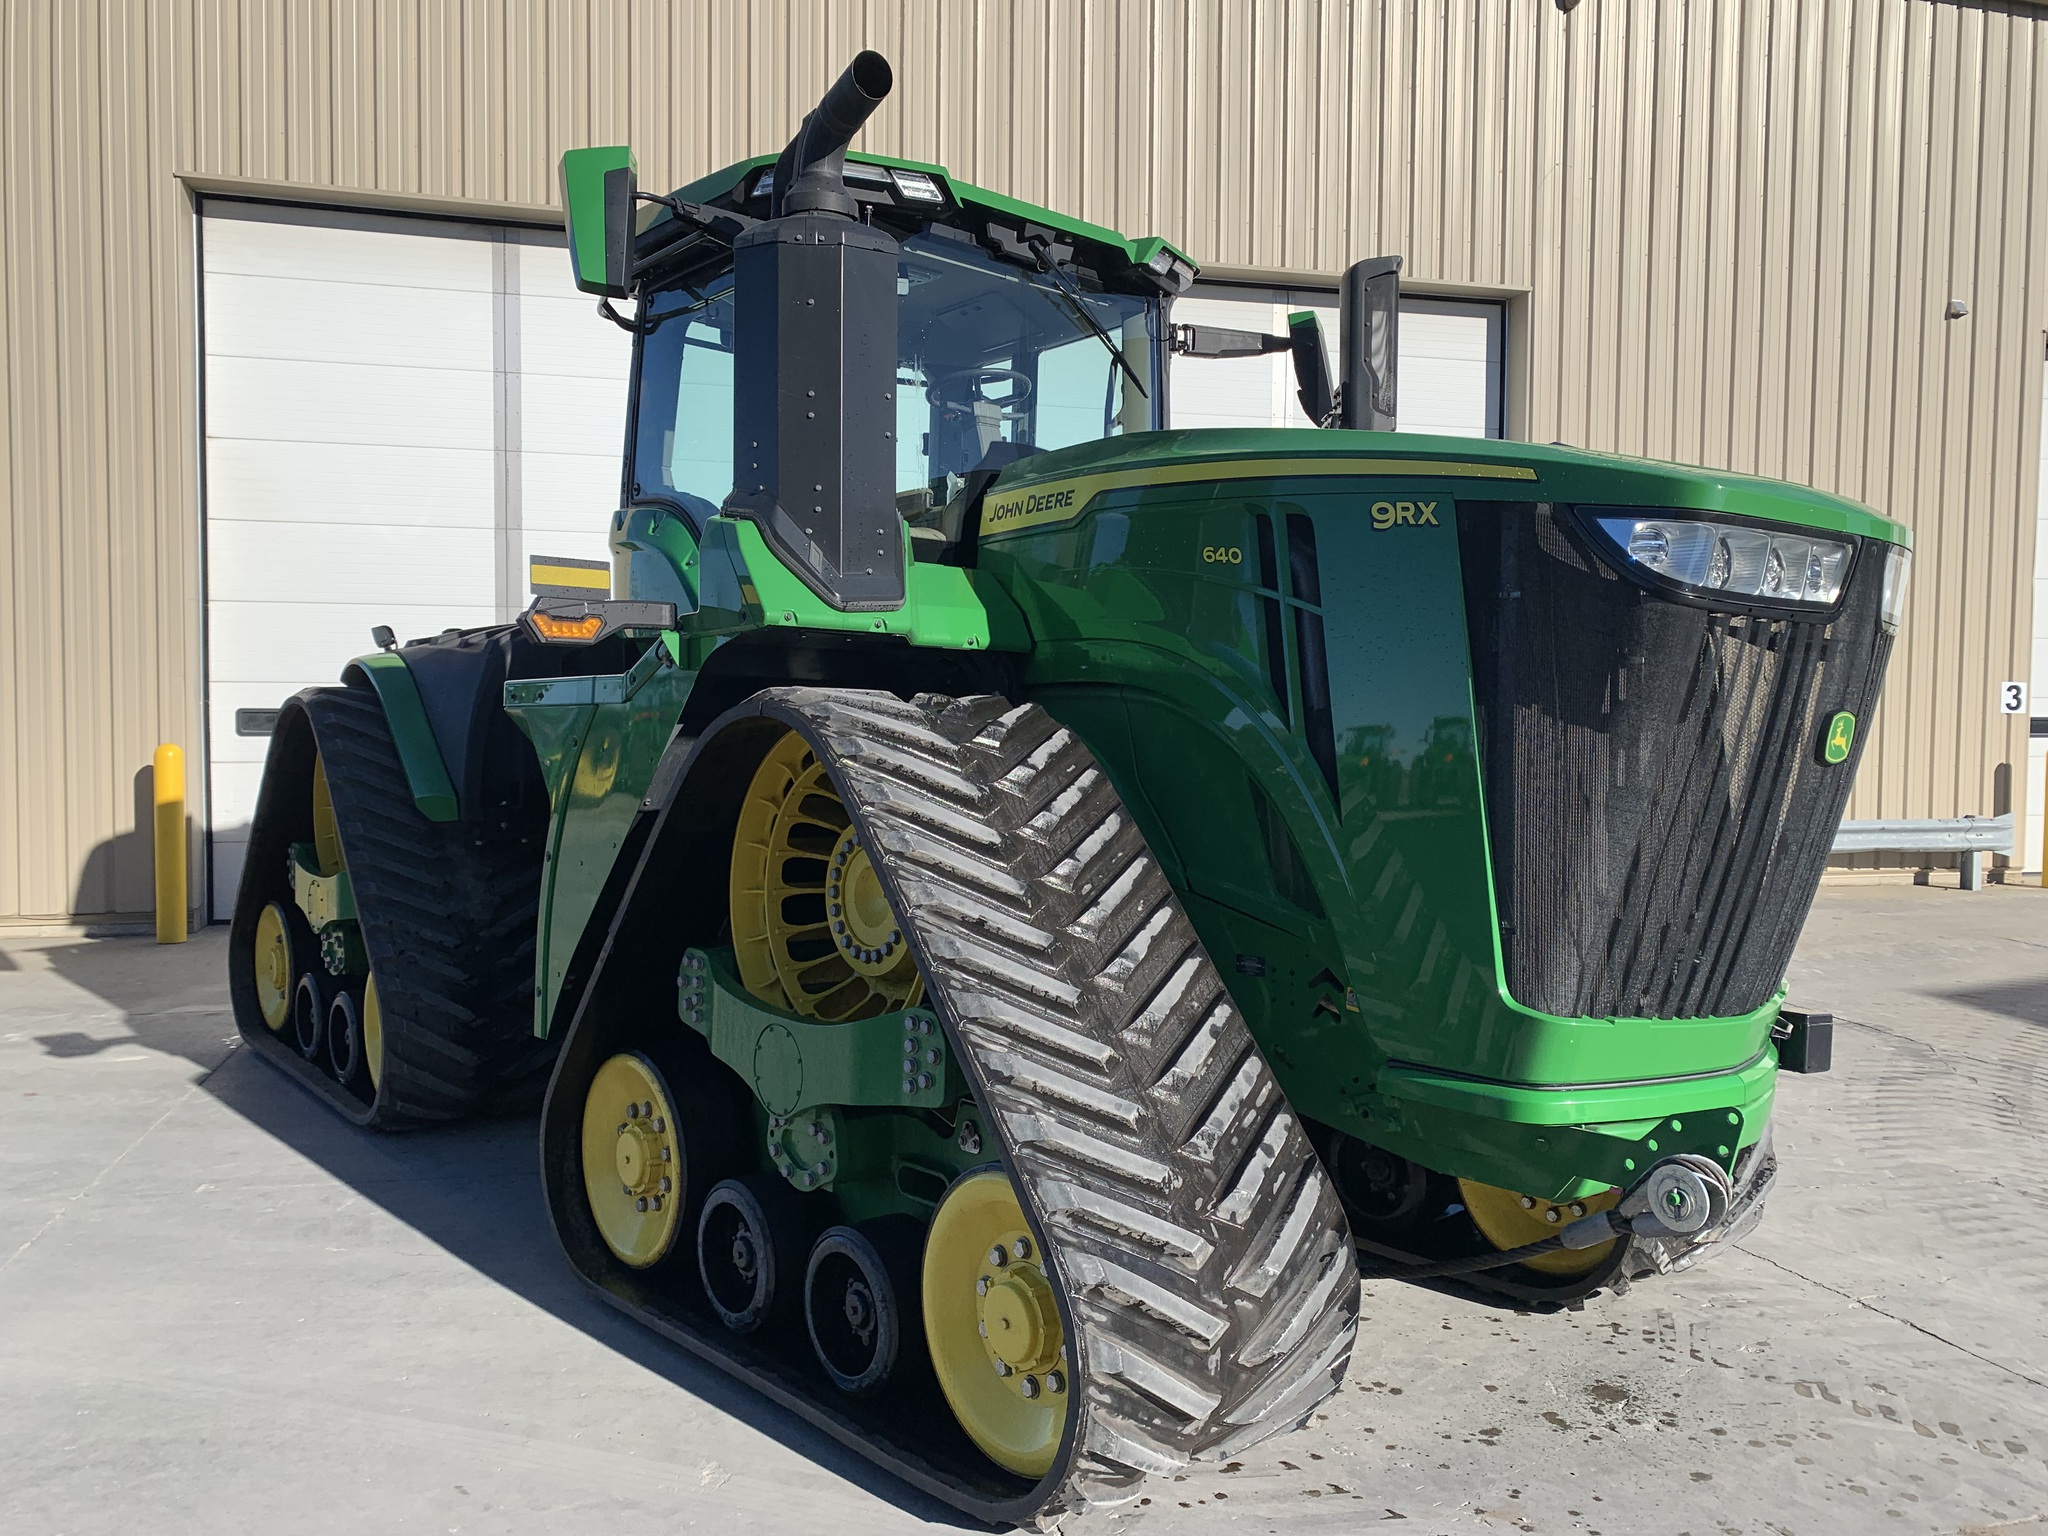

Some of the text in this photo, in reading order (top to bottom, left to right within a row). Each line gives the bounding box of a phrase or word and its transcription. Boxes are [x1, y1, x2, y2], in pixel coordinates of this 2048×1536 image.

[988, 489, 1076, 523] JOHN DEERE
[1370, 500, 1440, 531] 9RX
[1202, 546, 1242, 565] 640
[2005, 685, 2022, 711] 3
